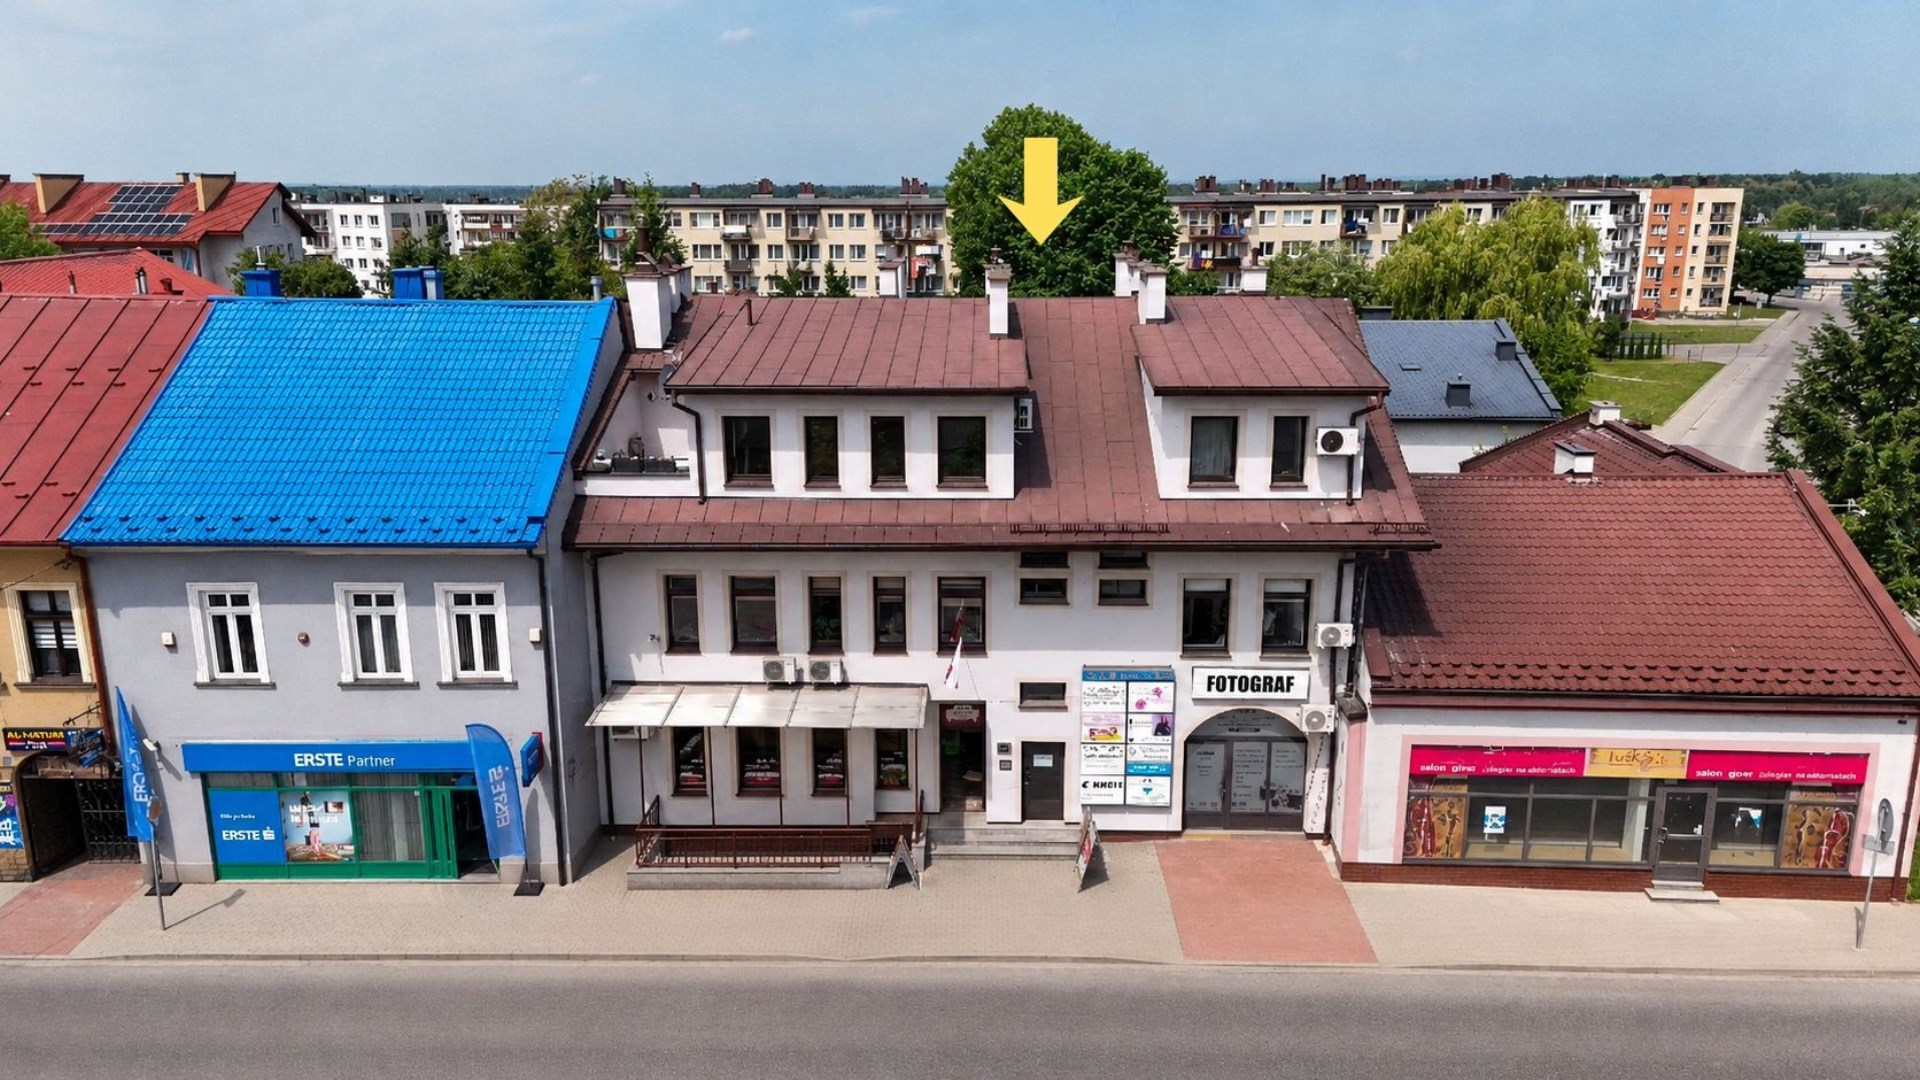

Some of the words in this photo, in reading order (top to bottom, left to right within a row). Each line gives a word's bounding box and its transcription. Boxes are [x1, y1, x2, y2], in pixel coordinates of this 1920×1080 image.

[1207, 675, 1295, 693] FOTOGRAF
[294, 753, 344, 766] ERSTE
[347, 755, 396, 766] Partner
[222, 830, 260, 840] ERSTE
